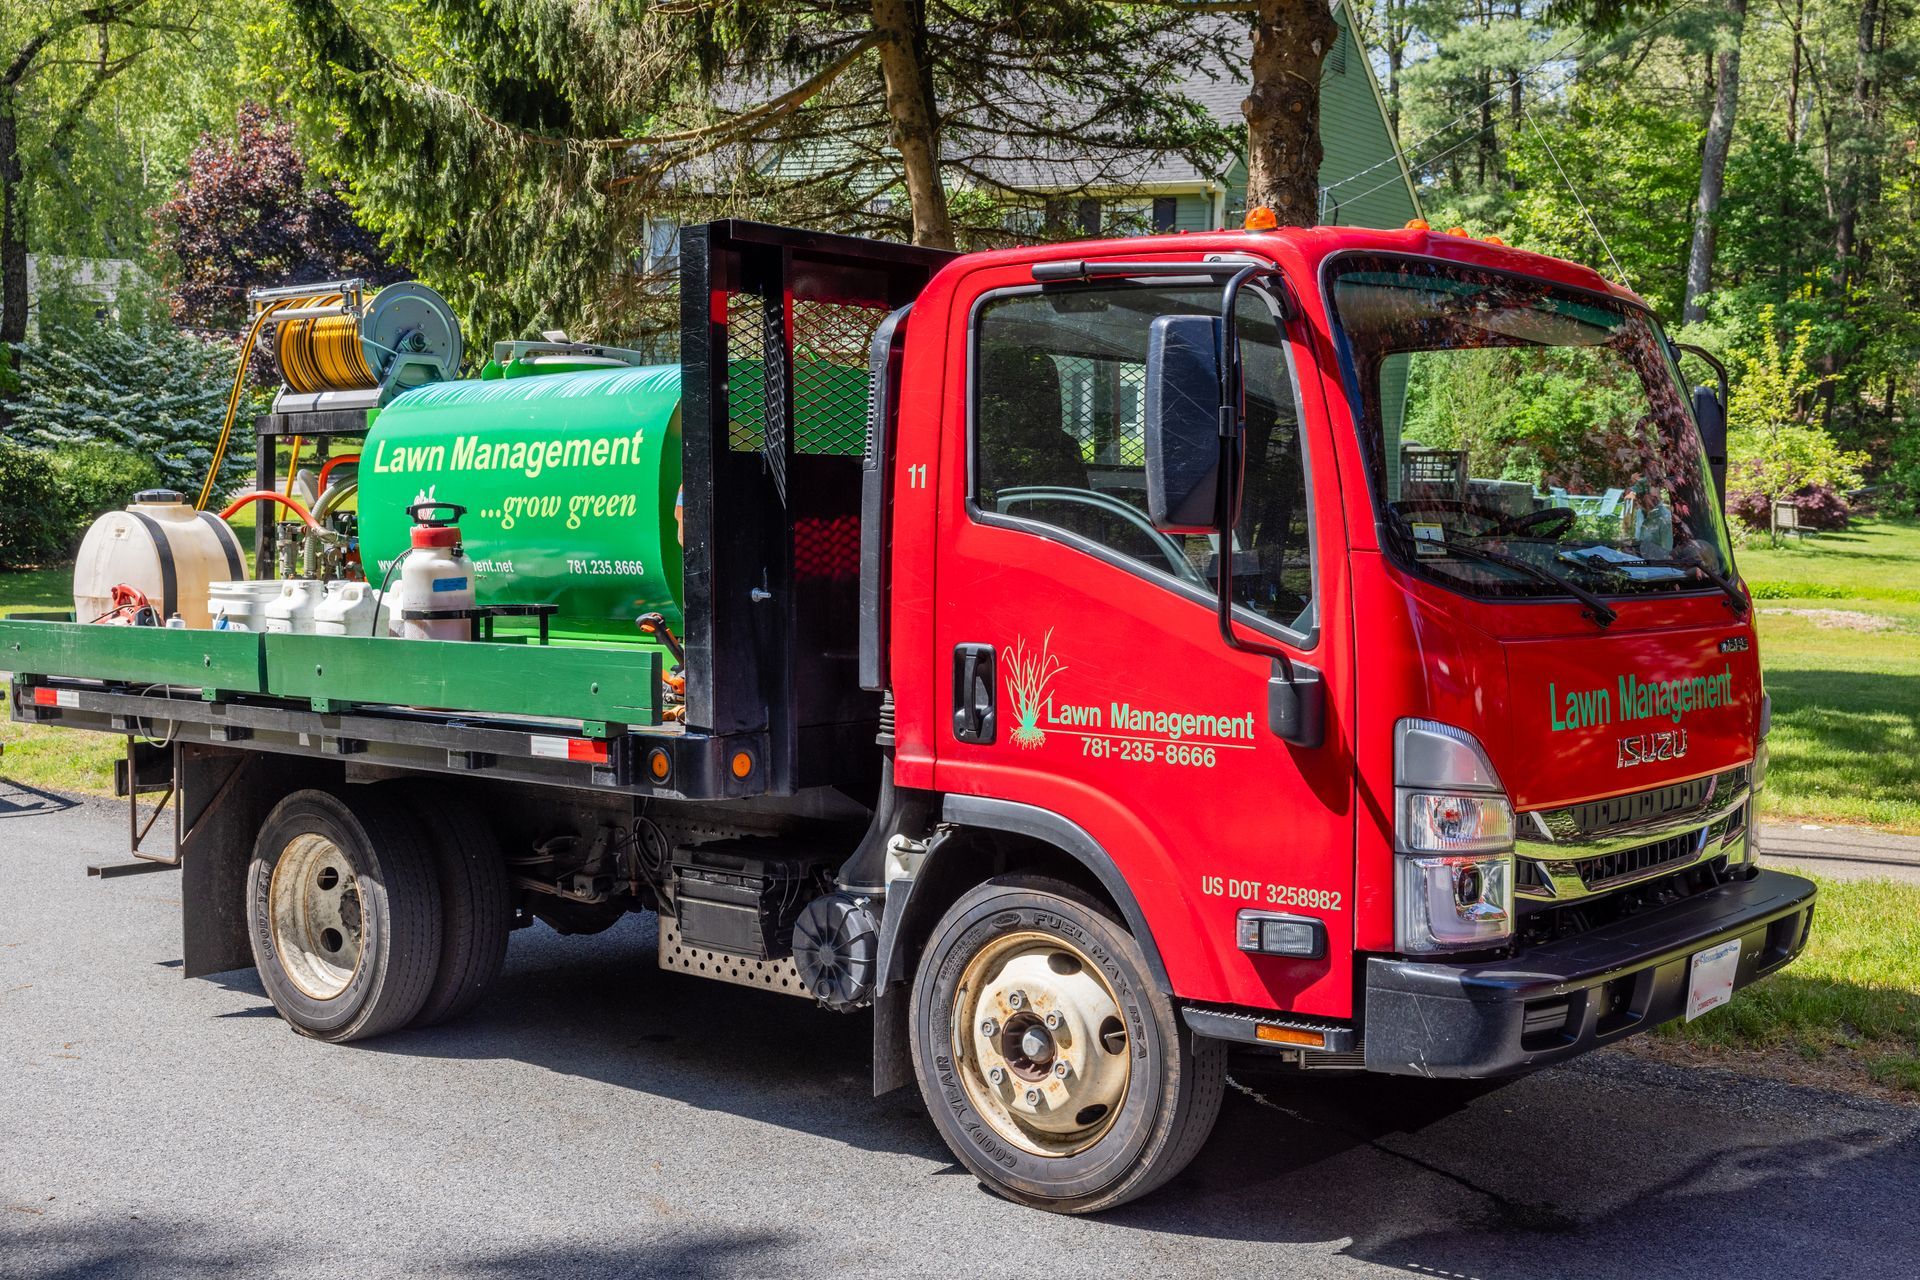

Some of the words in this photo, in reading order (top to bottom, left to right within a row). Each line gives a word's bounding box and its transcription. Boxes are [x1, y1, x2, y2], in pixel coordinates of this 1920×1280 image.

[374, 440, 445, 473] Lawn
[450, 428, 644, 478] Management
[908, 463, 927, 489] 11
[566, 494, 637, 530] green
[567, 560, 644, 575] 781.235.8666
[1550, 682, 1611, 732] Lawn
[1618, 663, 1733, 724] Management
[1047, 697, 1102, 727] Lawn
[1111, 702, 1255, 740] Management
[1081, 737, 1216, 768] 781-235-8666
[1617, 728, 1688, 769] ISUZU
[1202, 875, 1224, 896] US
[1229, 879, 1262, 901] DOT
[1266, 884, 1342, 911] 3258982
[1033, 911, 1086, 945] FUEL
[1091, 944, 1132, 996] MAX
